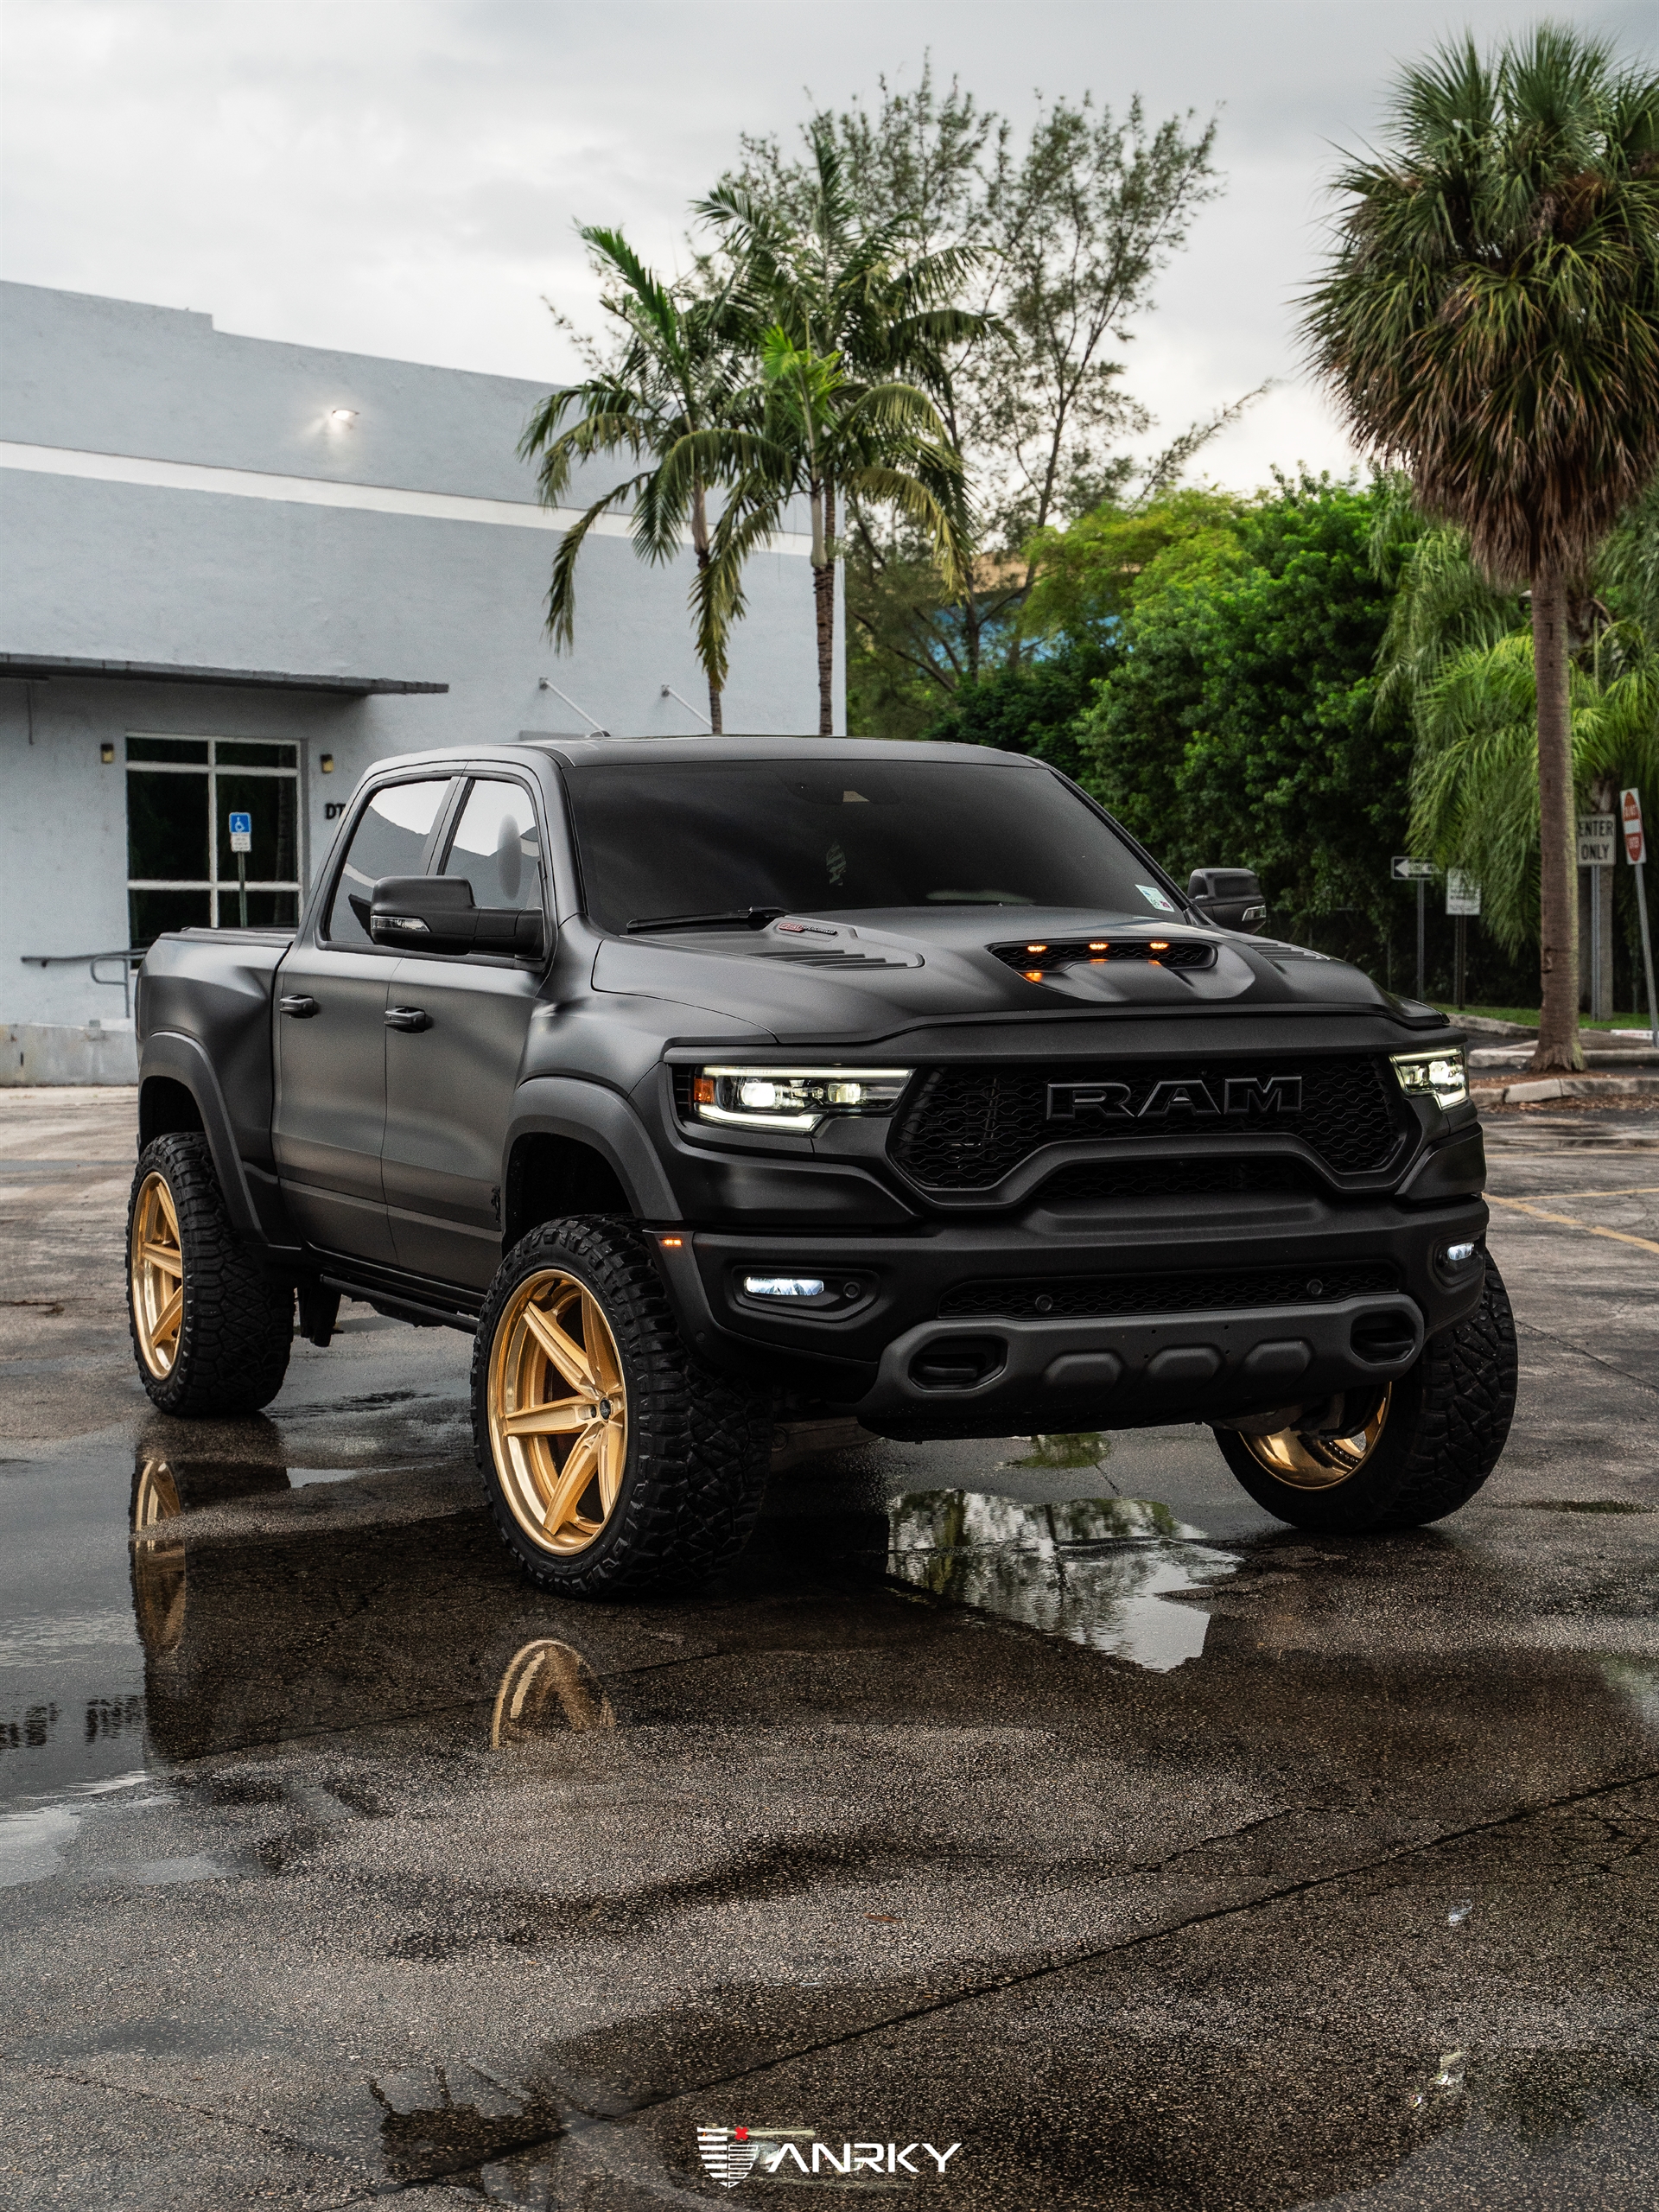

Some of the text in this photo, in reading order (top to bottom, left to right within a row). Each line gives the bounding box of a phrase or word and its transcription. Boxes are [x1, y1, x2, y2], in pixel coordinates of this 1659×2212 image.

[1578, 820, 1613, 836] ENTER
[1581, 844, 1609, 860] ONLY
[1046, 1076, 1302, 1121] RAM
